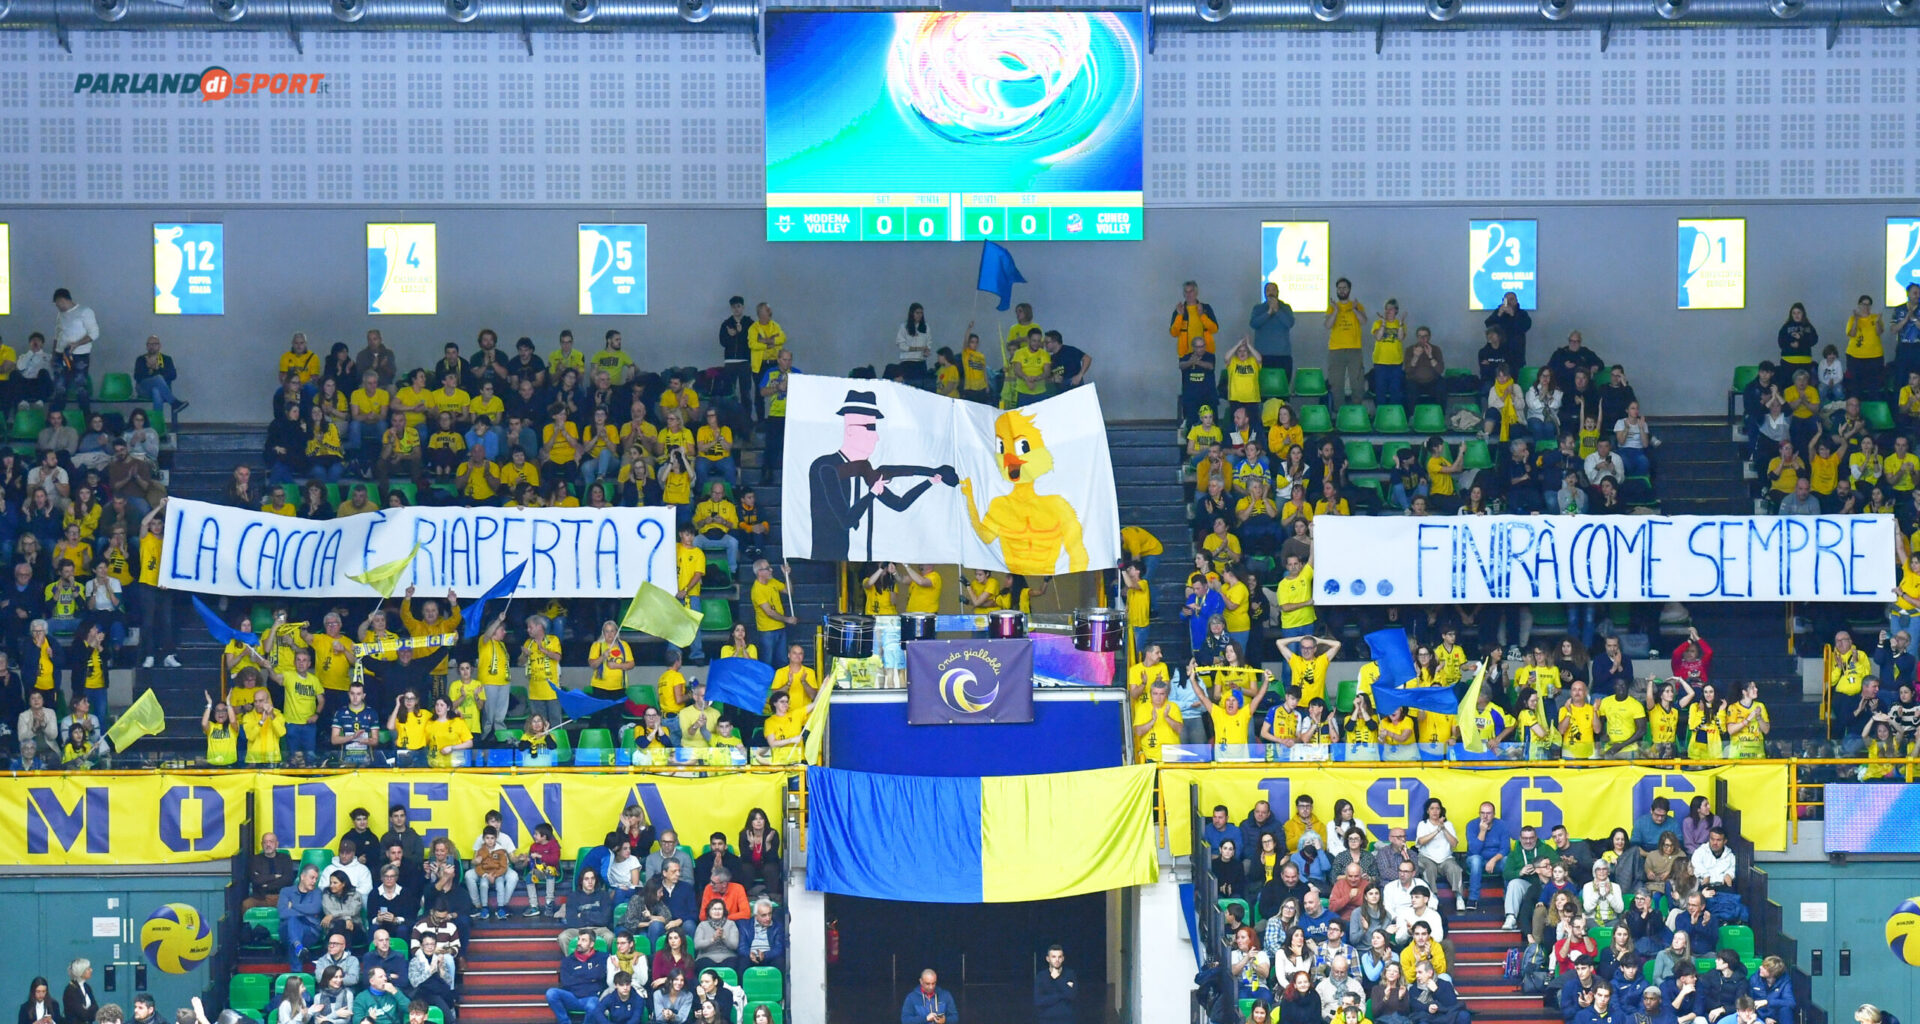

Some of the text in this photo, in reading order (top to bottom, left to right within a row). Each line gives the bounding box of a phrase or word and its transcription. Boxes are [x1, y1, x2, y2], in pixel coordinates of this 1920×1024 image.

[803, 213, 851, 224] MODENA
[806, 223, 848, 234] VOLLEY
[876, 215, 892, 235] 0
[918, 217, 934, 237] 0
[978, 215, 994, 235] 0
[1020, 214, 1036, 234] 0
[1096, 223, 1132, 234] VOLLEY
[1097, 212, 1130, 223] CUNEO
[183, 240, 215, 271] 12
[405, 241, 421, 269] 4
[615, 240, 632, 271] 5
[1296, 239, 1311, 267] 4
[1504, 236, 1521, 267] 3
[1717, 236, 1726, 264] 1
[171, 509, 220, 584] LA
[236, 521, 343, 590] CACCIA
[412, 516, 621, 591] RIAPERTA
[637, 517, 664, 583] ?
[1418, 519, 1562, 600] FINIRÀ
[1569, 519, 1673, 599] COME
[1688, 518, 1878, 598] SEMPRE
[938, 652, 962, 671] Onda
[27, 781, 680, 854] MODENA
[1257, 775, 1698, 842] 1966
